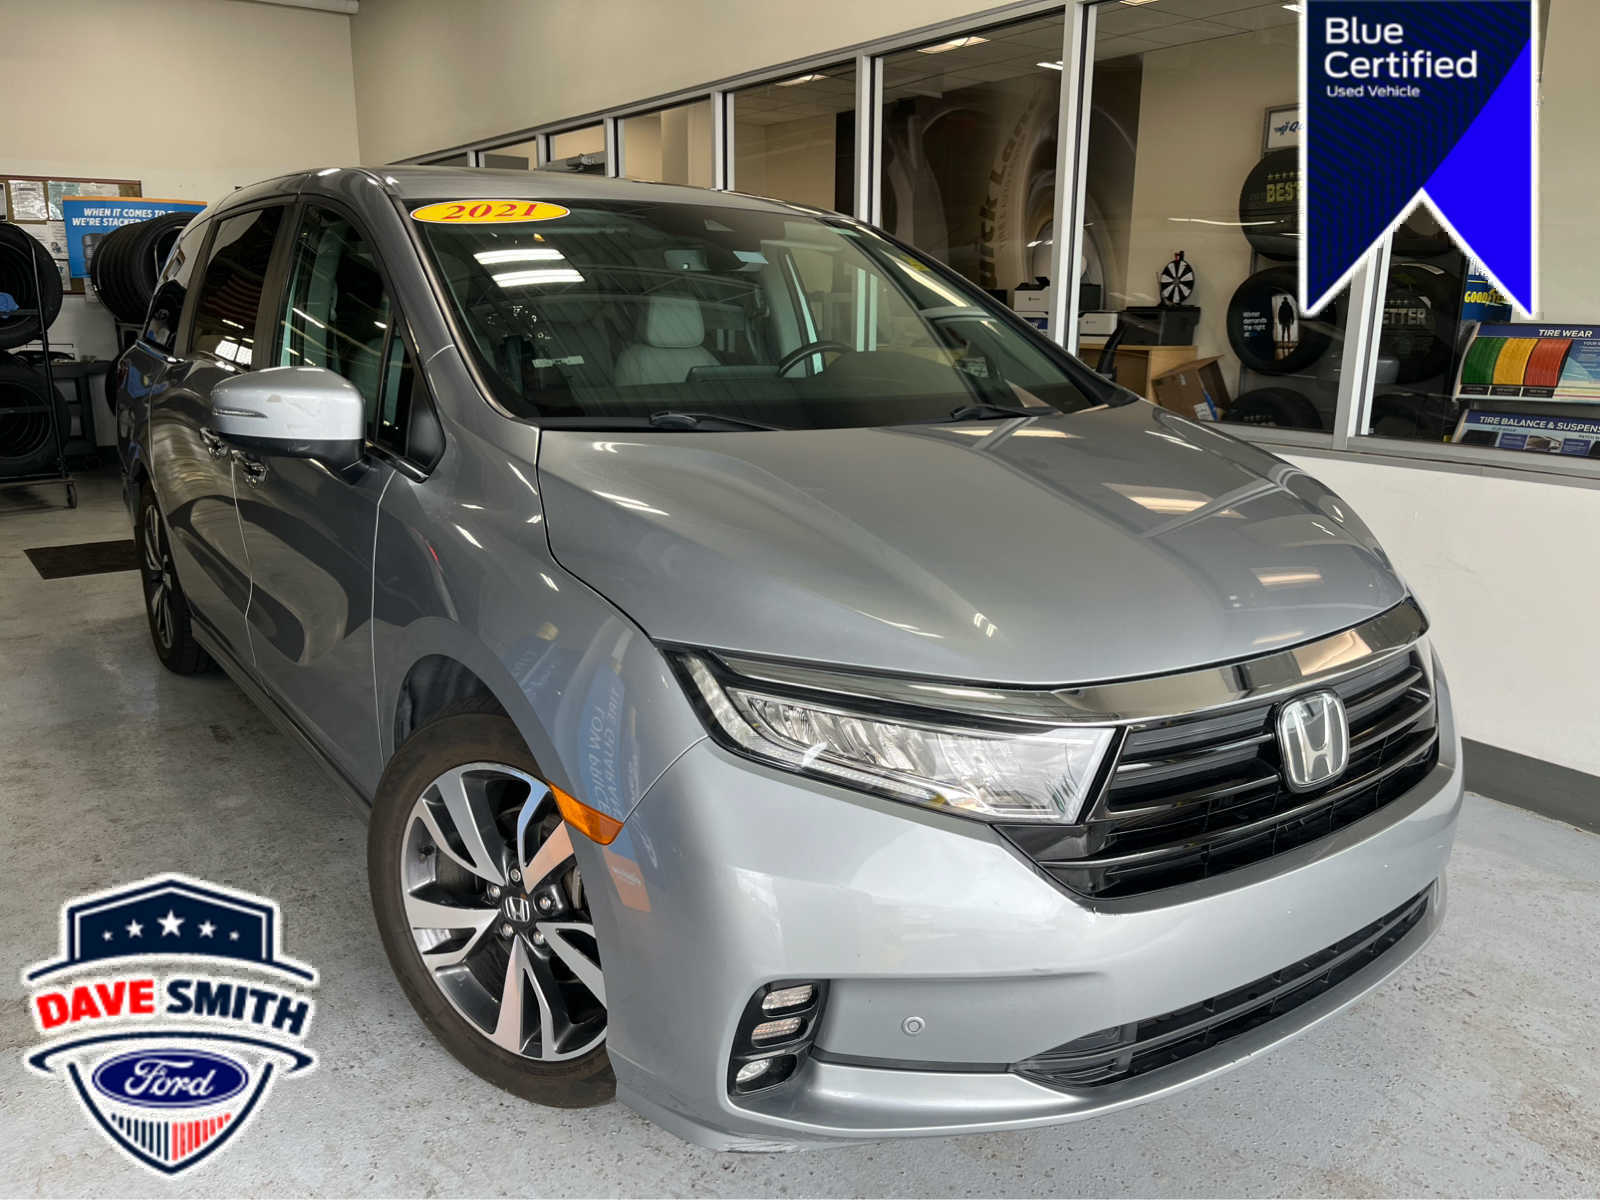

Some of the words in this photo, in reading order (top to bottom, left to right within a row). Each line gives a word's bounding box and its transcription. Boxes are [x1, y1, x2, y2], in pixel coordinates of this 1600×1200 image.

[83, 207, 111, 217] WHEN
[112, 208, 122, 217] IT
[122, 208, 153, 218] COMES
[440, 203, 538, 220] 2021
[72, 217, 101, 226] WE'RE
[1538, 329, 1560, 337] TIRE
[1562, 330, 1593, 338] WEAR
[1479, 416, 1501, 425] TIRE
[1500, 417, 1546, 429] BALANCE
